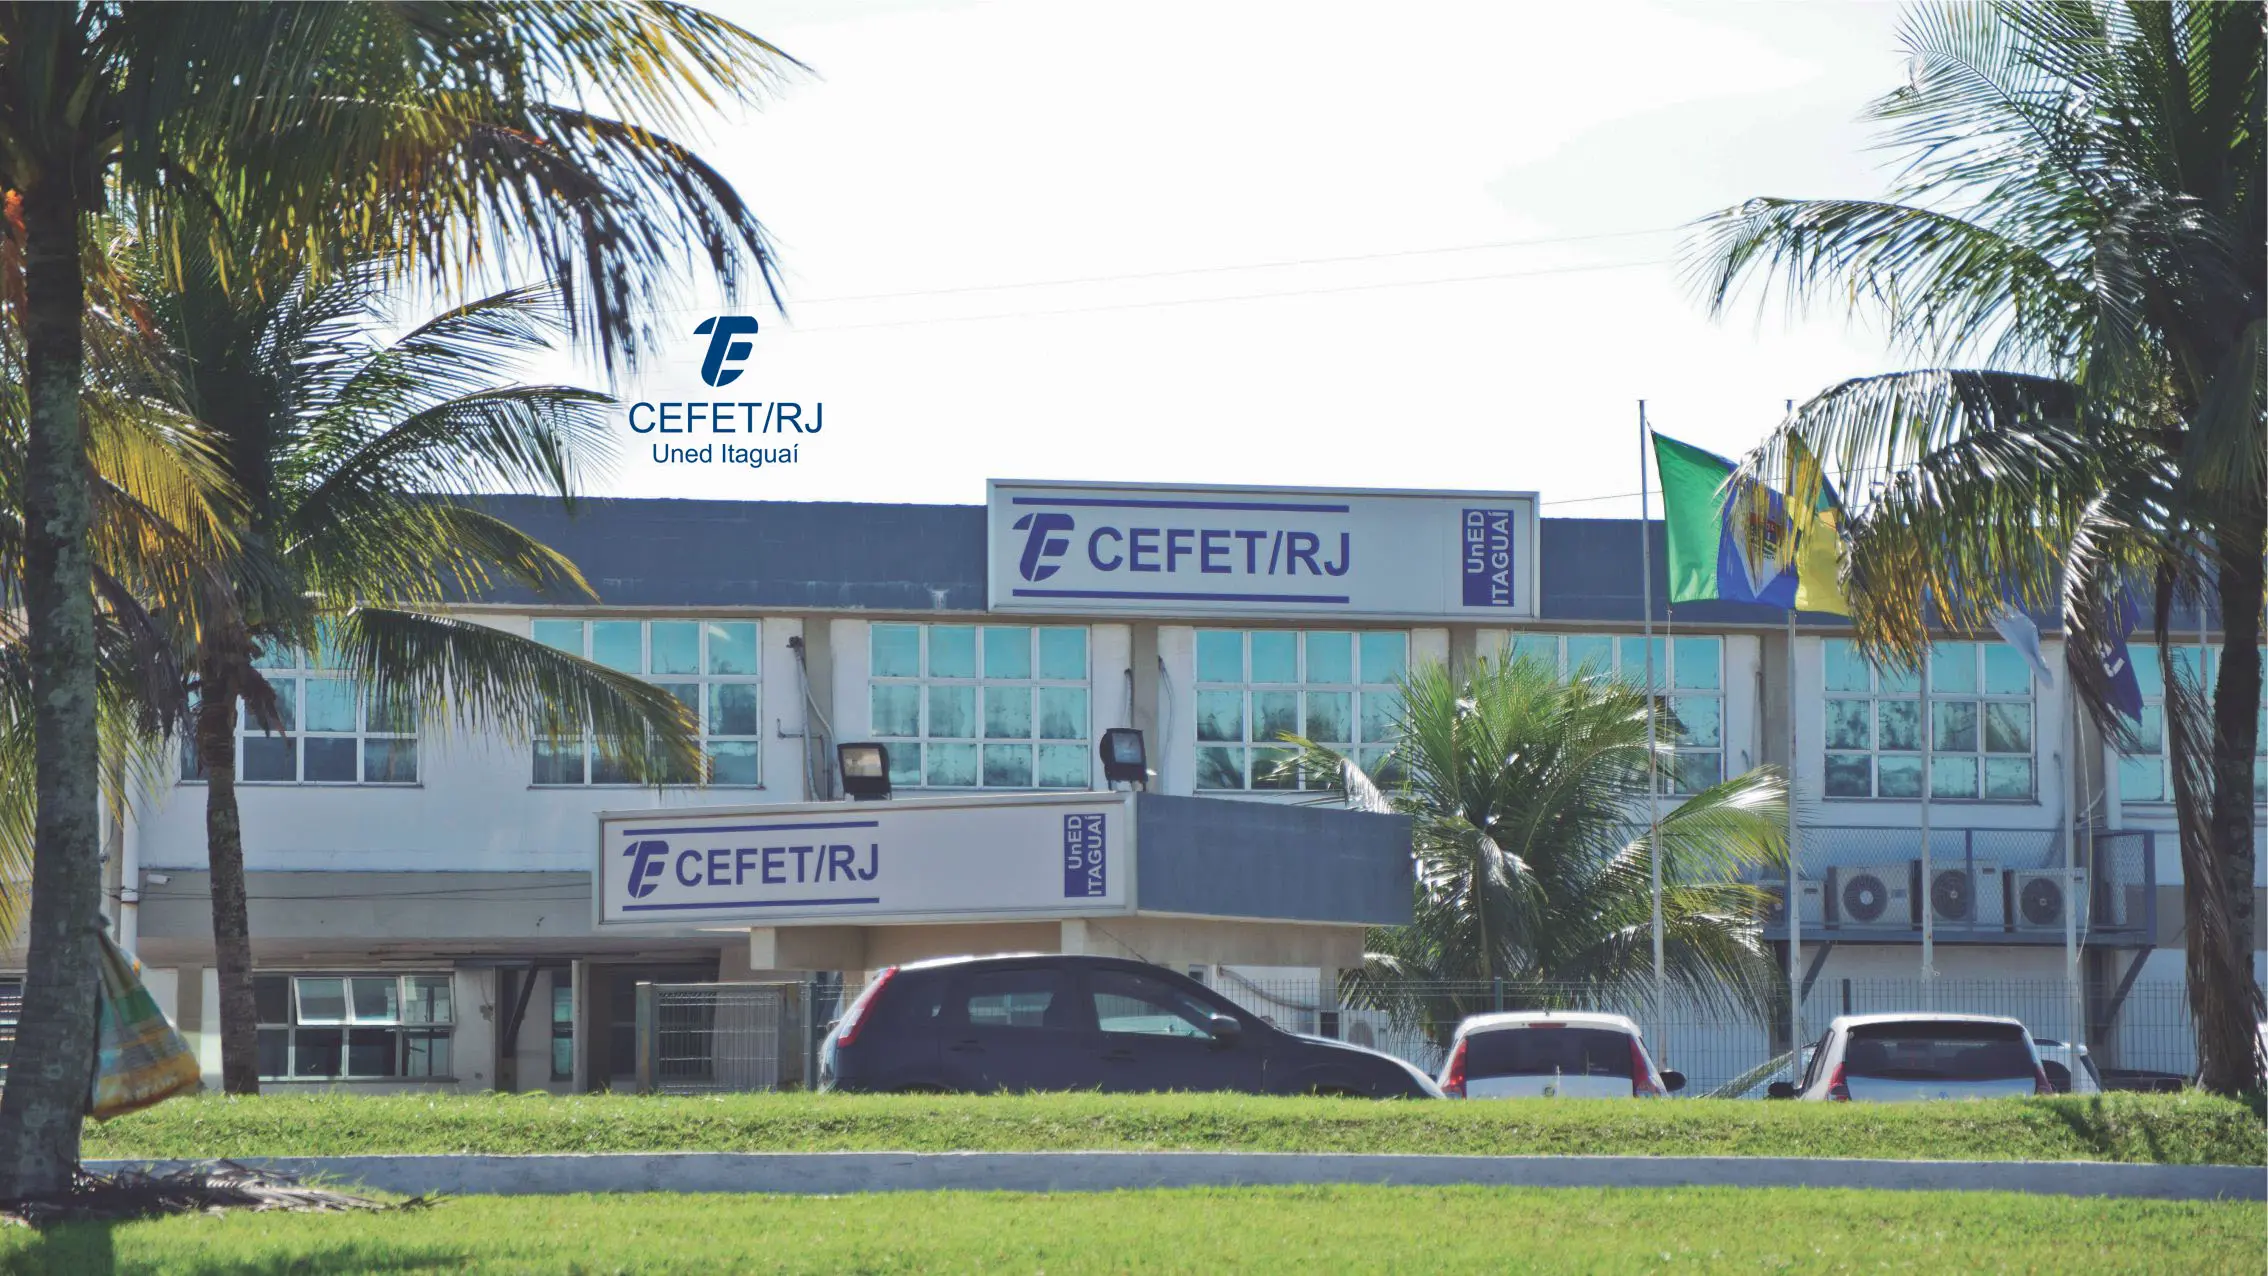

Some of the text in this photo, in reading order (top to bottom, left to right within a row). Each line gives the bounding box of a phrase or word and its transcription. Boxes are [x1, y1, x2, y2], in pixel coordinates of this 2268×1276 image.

[1088, 525, 1350, 577] CEFET/RJ
[1467, 511, 1485, 574] UnED
[1488, 511, 1509, 604] ITAGUAÍ
[675, 843, 879, 887] CEFET/RJ
[1068, 816, 1082, 869] UnED
[1085, 815, 1102, 895] ITAGUAÍ
